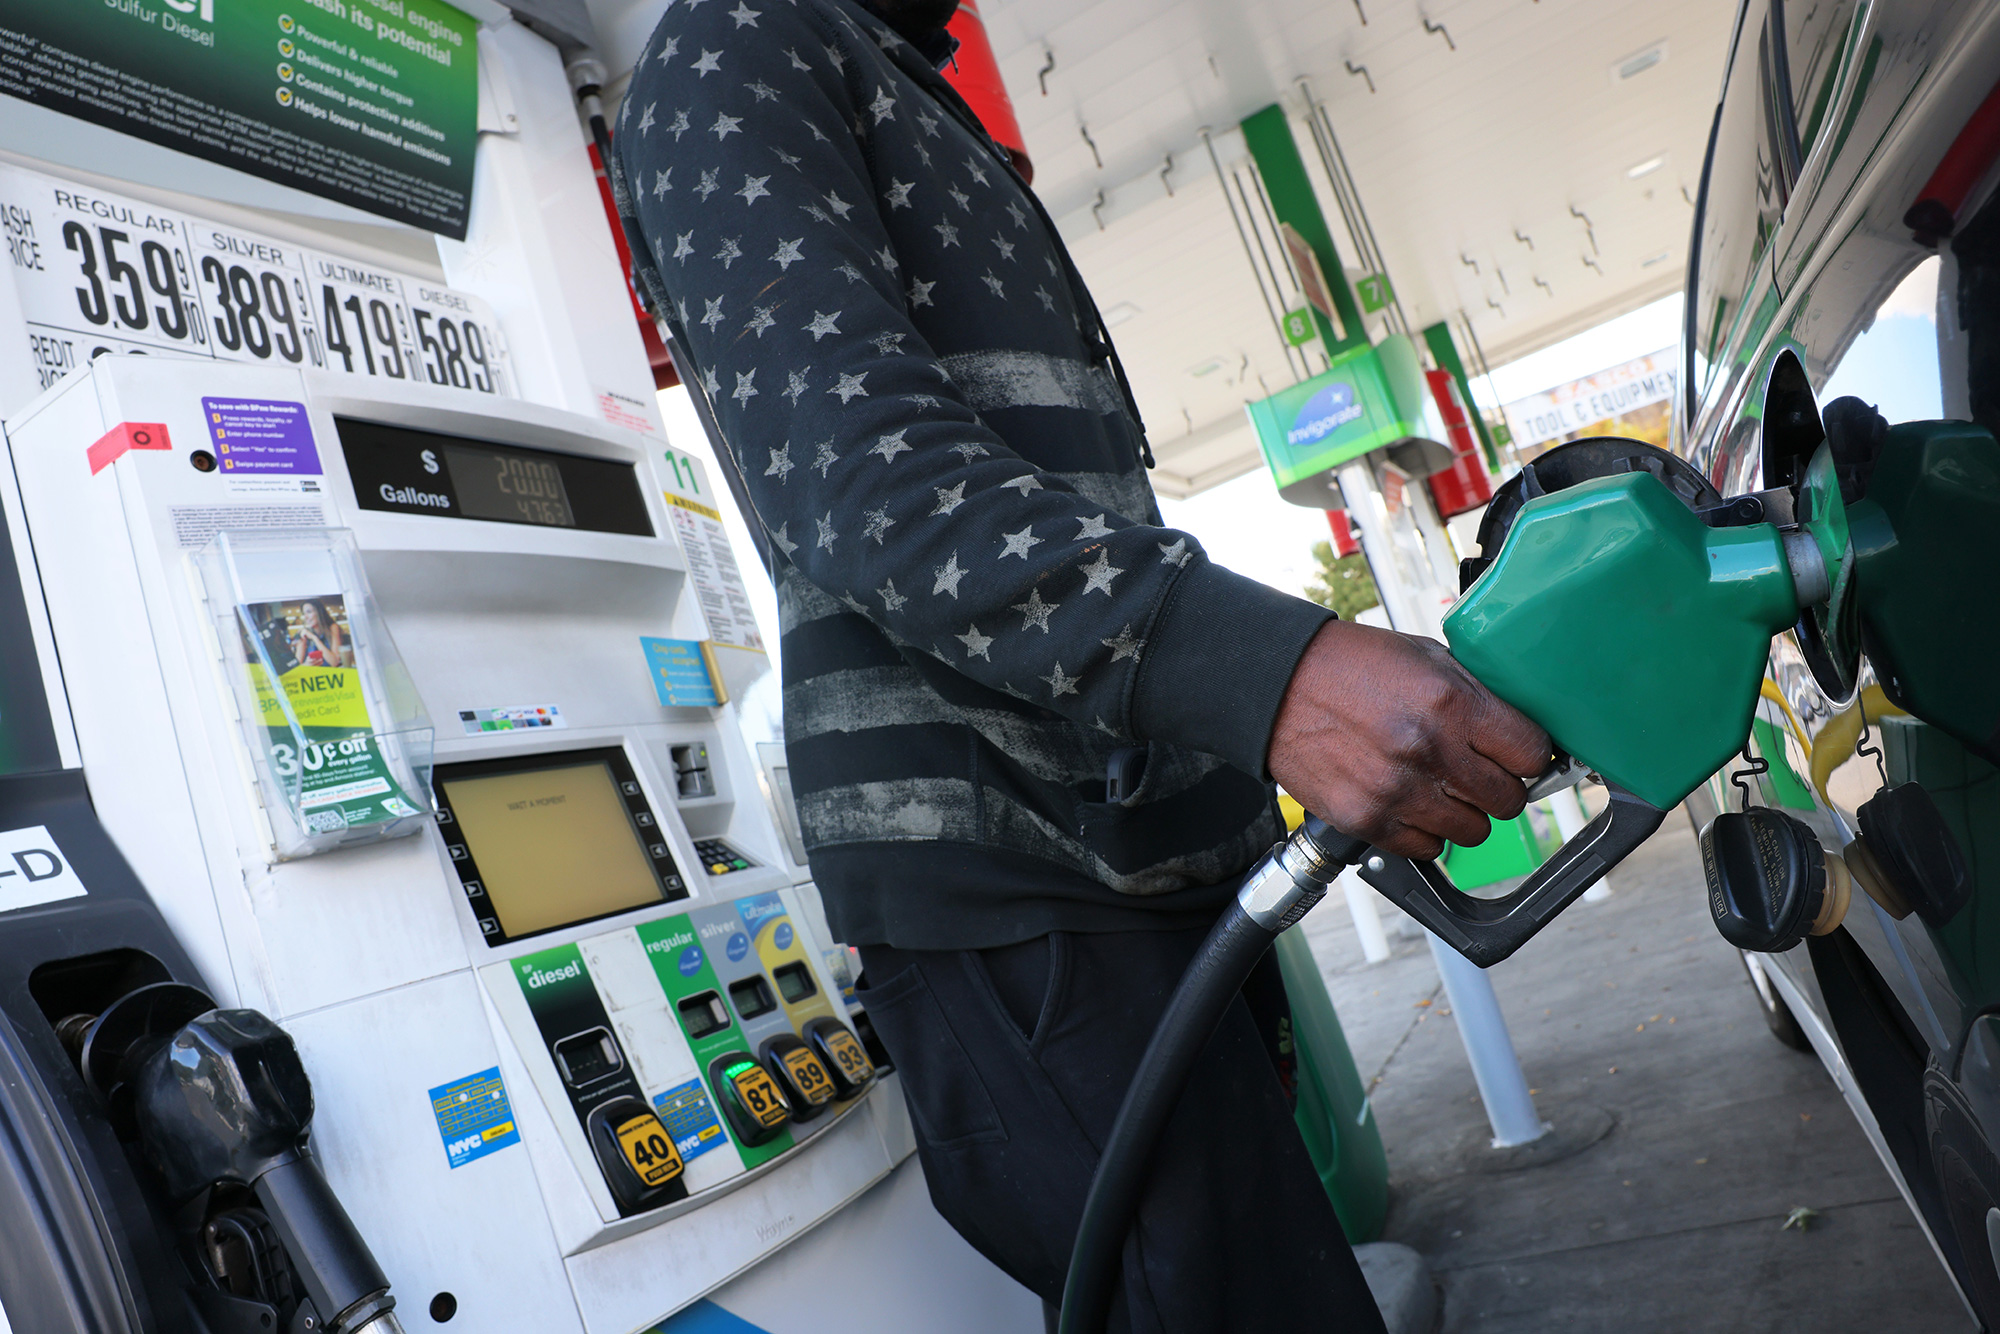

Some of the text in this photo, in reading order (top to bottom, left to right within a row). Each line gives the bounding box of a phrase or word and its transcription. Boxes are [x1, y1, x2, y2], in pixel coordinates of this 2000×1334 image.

[162, 12, 214, 48] Diesel
[351, 5, 374, 32] its
[377, 22, 451, 66] potential
[407, 10, 463, 46] engine
[1, 54, 52, 77] corrosion
[297, 25, 398, 79] Powerful & reliable
[25, 75, 75, 97] advanced
[296, 49, 414, 107] Delivers higher torque
[295, 73, 445, 141] Contains protective additives
[294, 97, 451, 166] Helps lower harmful emissions
[54, 189, 177, 236] REGULAR
[212, 232, 285, 266] SILVER
[175, 248, 190, 291] 9
[319, 260, 396, 294] ULTIMATE
[419, 288, 473, 314] DIESEL
[1365, 281, 1379, 303] 7
[184, 301, 206, 345] 10
[202, 255, 303, 363] 389
[323, 284, 405, 379] 419
[1289, 316, 1305, 338] 8
[412, 308, 495, 394] 589
[1525, 408, 1570, 439] TOOL
[420, 449, 439, 475] $
[665, 450, 699, 494] 11
[379, 484, 450, 508] Gallons
[300, 673, 344, 693] NEW
[318, 705, 340, 716] Card
[338, 732, 368, 755] off
[328, 753, 373, 768] every gallon
[1759, 822, 1782, 897] REMOVE SLOWLY
[1770, 839, 1786, 880] CAUTION
[1706, 860, 1716, 881] UNTIL
[1714, 891, 1725, 913] CLICK
[744, 901, 784, 920] ultimate
[646, 932, 694, 954] regular
[700, 920, 736, 938] silver
[528, 960, 581, 989] diesel
[838, 1045, 864, 1070] 93
[795, 1063, 825, 1090] 89
[747, 1081, 780, 1112] 87
[448, 1134, 482, 1157] NYC
[635, 1134, 669, 1166] 40
[754, 1212, 795, 1243] Wayne
